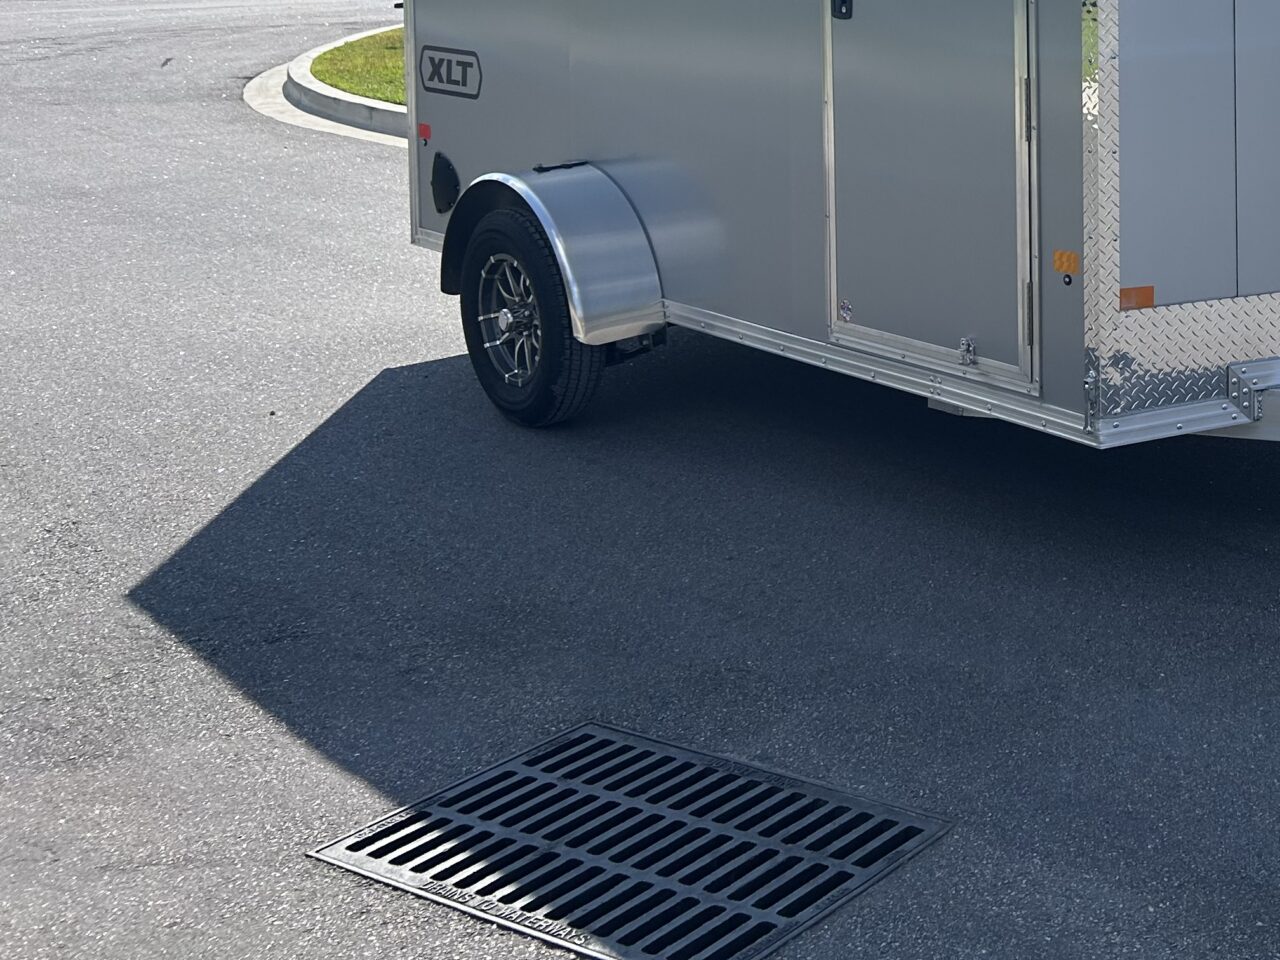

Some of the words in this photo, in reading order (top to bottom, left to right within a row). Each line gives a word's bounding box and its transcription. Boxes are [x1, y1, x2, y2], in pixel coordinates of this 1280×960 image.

[427, 56, 474, 87] XLT
[422, 881, 475, 903] DRAINS
[475, 898, 499, 911] TO
[499, 907, 590, 944] WATERWAYS
